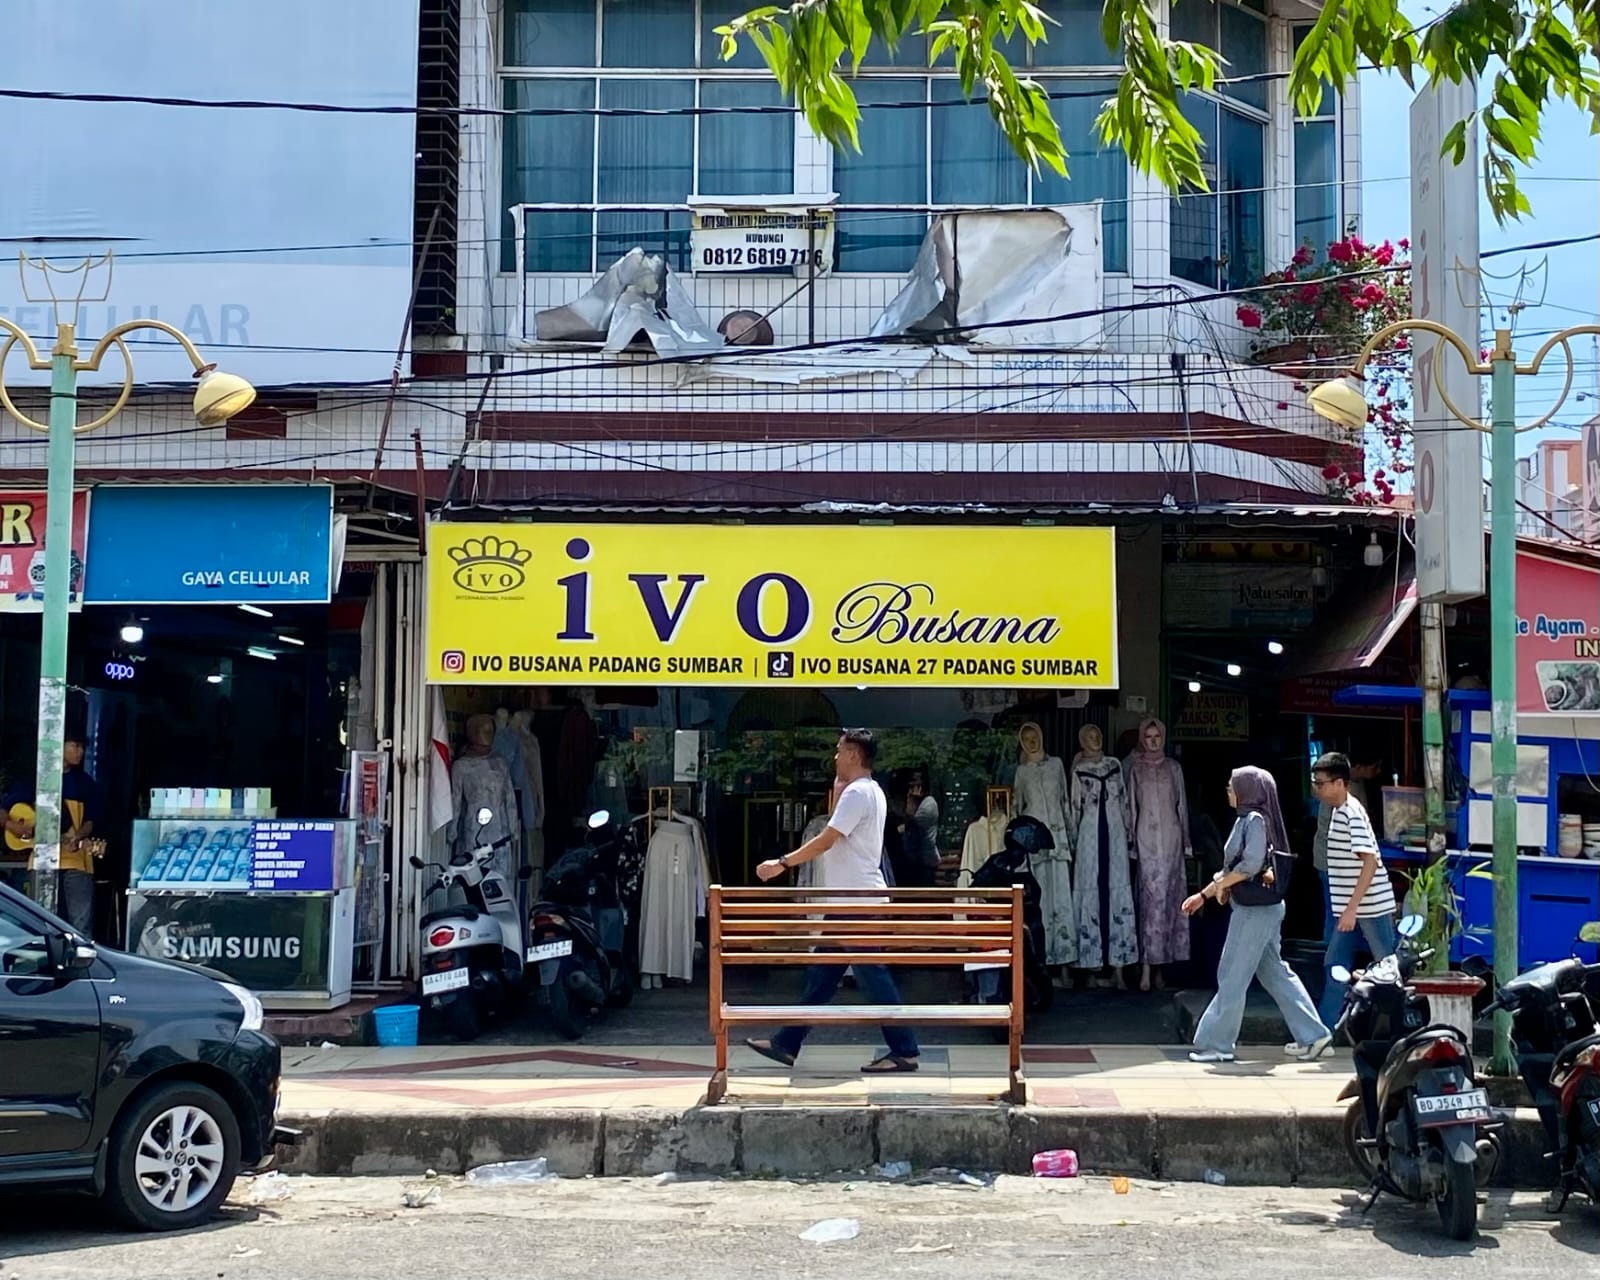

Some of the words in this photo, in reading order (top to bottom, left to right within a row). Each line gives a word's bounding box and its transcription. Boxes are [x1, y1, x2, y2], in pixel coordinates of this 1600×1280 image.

[745, 233, 784, 243] HUBUNGI
[703, 247, 743, 265] 0812
[747, 247, 787, 265] 6819
[790, 248, 823, 265] 716
[182, 571, 224, 585] GAYA
[228, 570, 310, 585] CELLULAR
[832, 582, 1061, 645] Busana
[1535, 614, 1586, 641] Ayam
[105, 662, 135, 680] oppo
[472, 655, 503, 672] IVO
[509, 656, 583, 673] BUSANA
[588, 657, 661, 673] PADANG
[667, 658, 743, 673] SUMBAR
[800, 658, 831, 674] IVO
[837, 658, 911, 675] BUSANA
[916, 659, 937, 675] 27
[943, 659, 1016, 676] PADANG
[1021, 659, 1098, 676] SUMBAR
[162, 936, 301, 959] SAMSUNG
